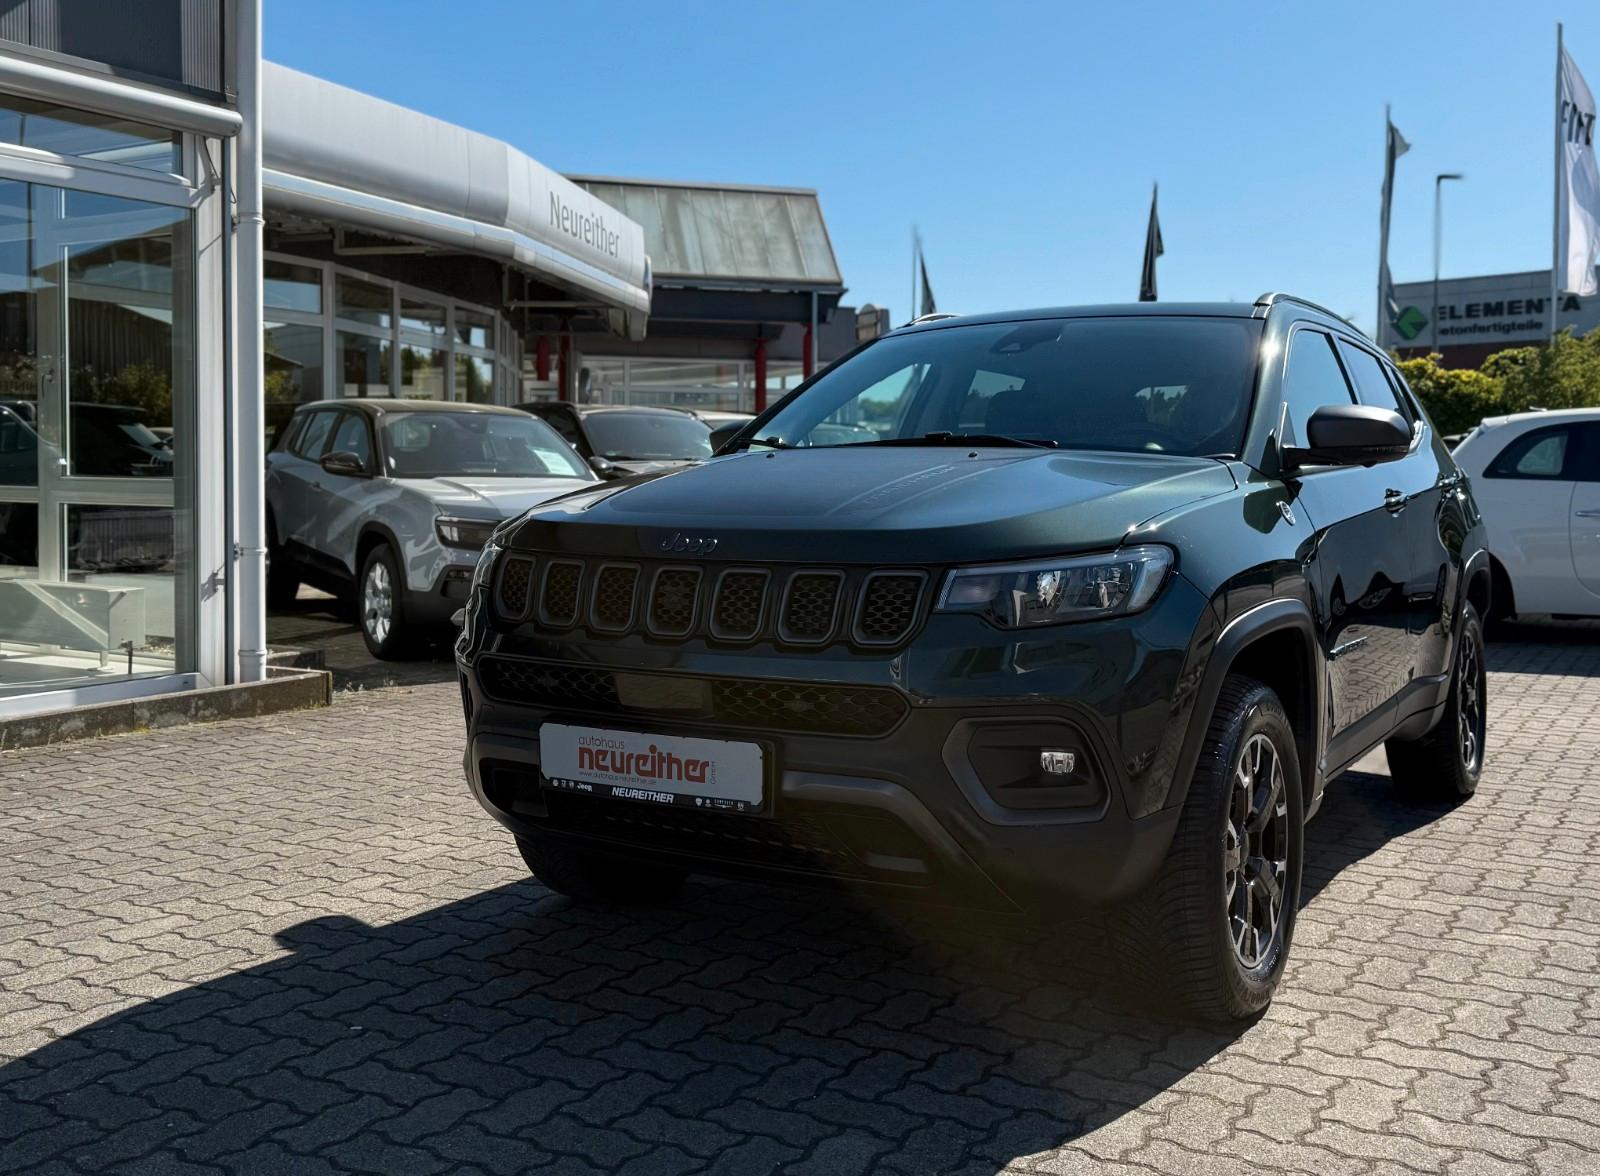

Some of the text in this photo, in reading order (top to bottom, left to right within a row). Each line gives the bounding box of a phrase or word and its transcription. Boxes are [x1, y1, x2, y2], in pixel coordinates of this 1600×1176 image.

[550, 191, 620, 258] Neureither
[1437, 319, 1543, 337] etonfertigteile
[660, 532, 718, 555] Jeep
[578, 736, 625, 749] autohaus
[578, 744, 710, 784] neureither
[577, 782, 593, 792] Jeep
[611, 786, 674, 803] NEUREITHER
